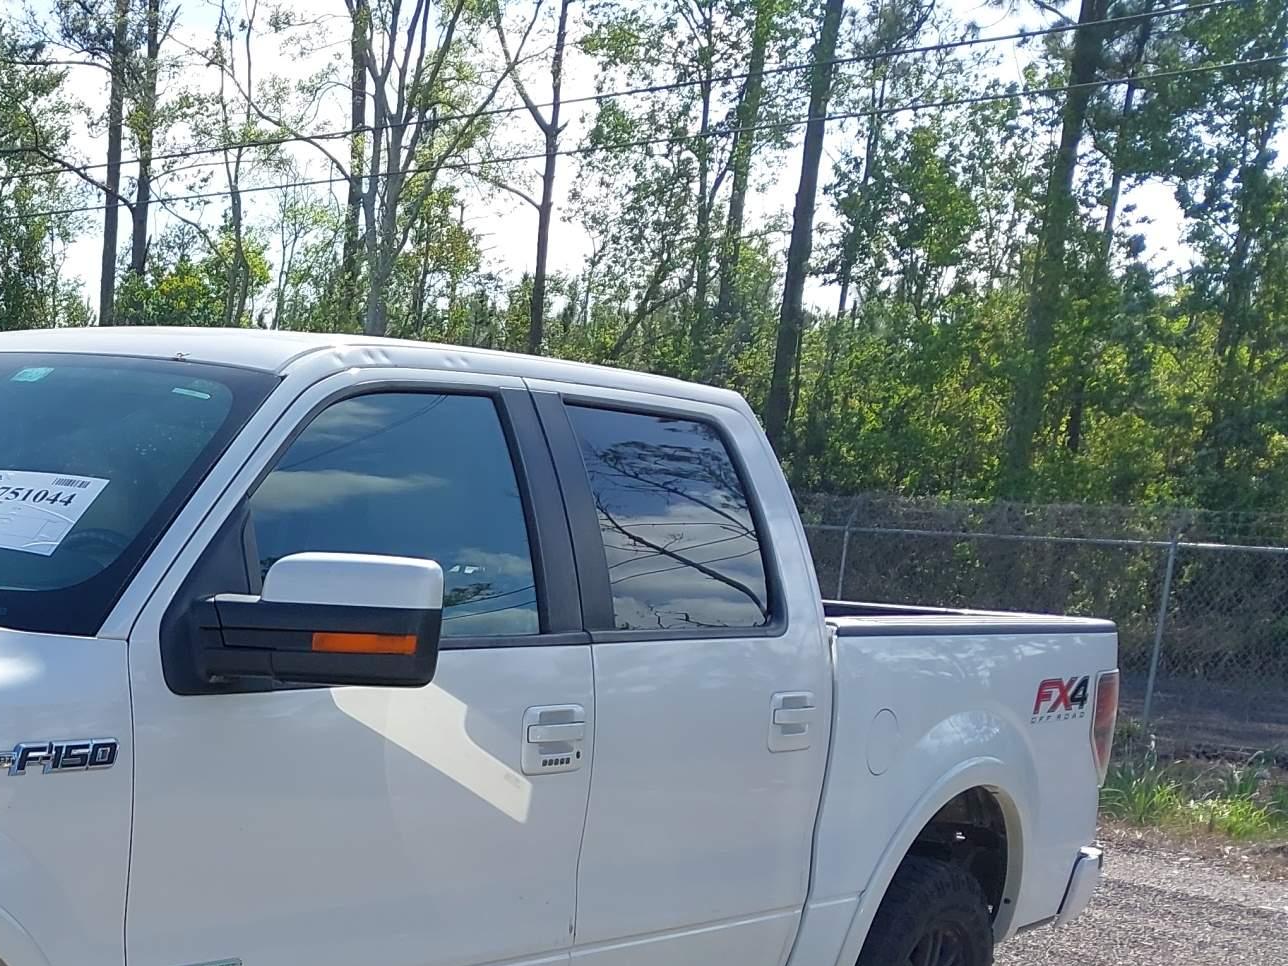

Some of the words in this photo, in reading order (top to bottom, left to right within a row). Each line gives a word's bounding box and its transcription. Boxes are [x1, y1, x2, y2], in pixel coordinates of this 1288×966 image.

[1033, 675, 1090, 715] FX4
[1030, 715, 1053, 724] OFF
[1056, 711, 1086, 721] ROAD
[9, 738, 119, 776] F-150
